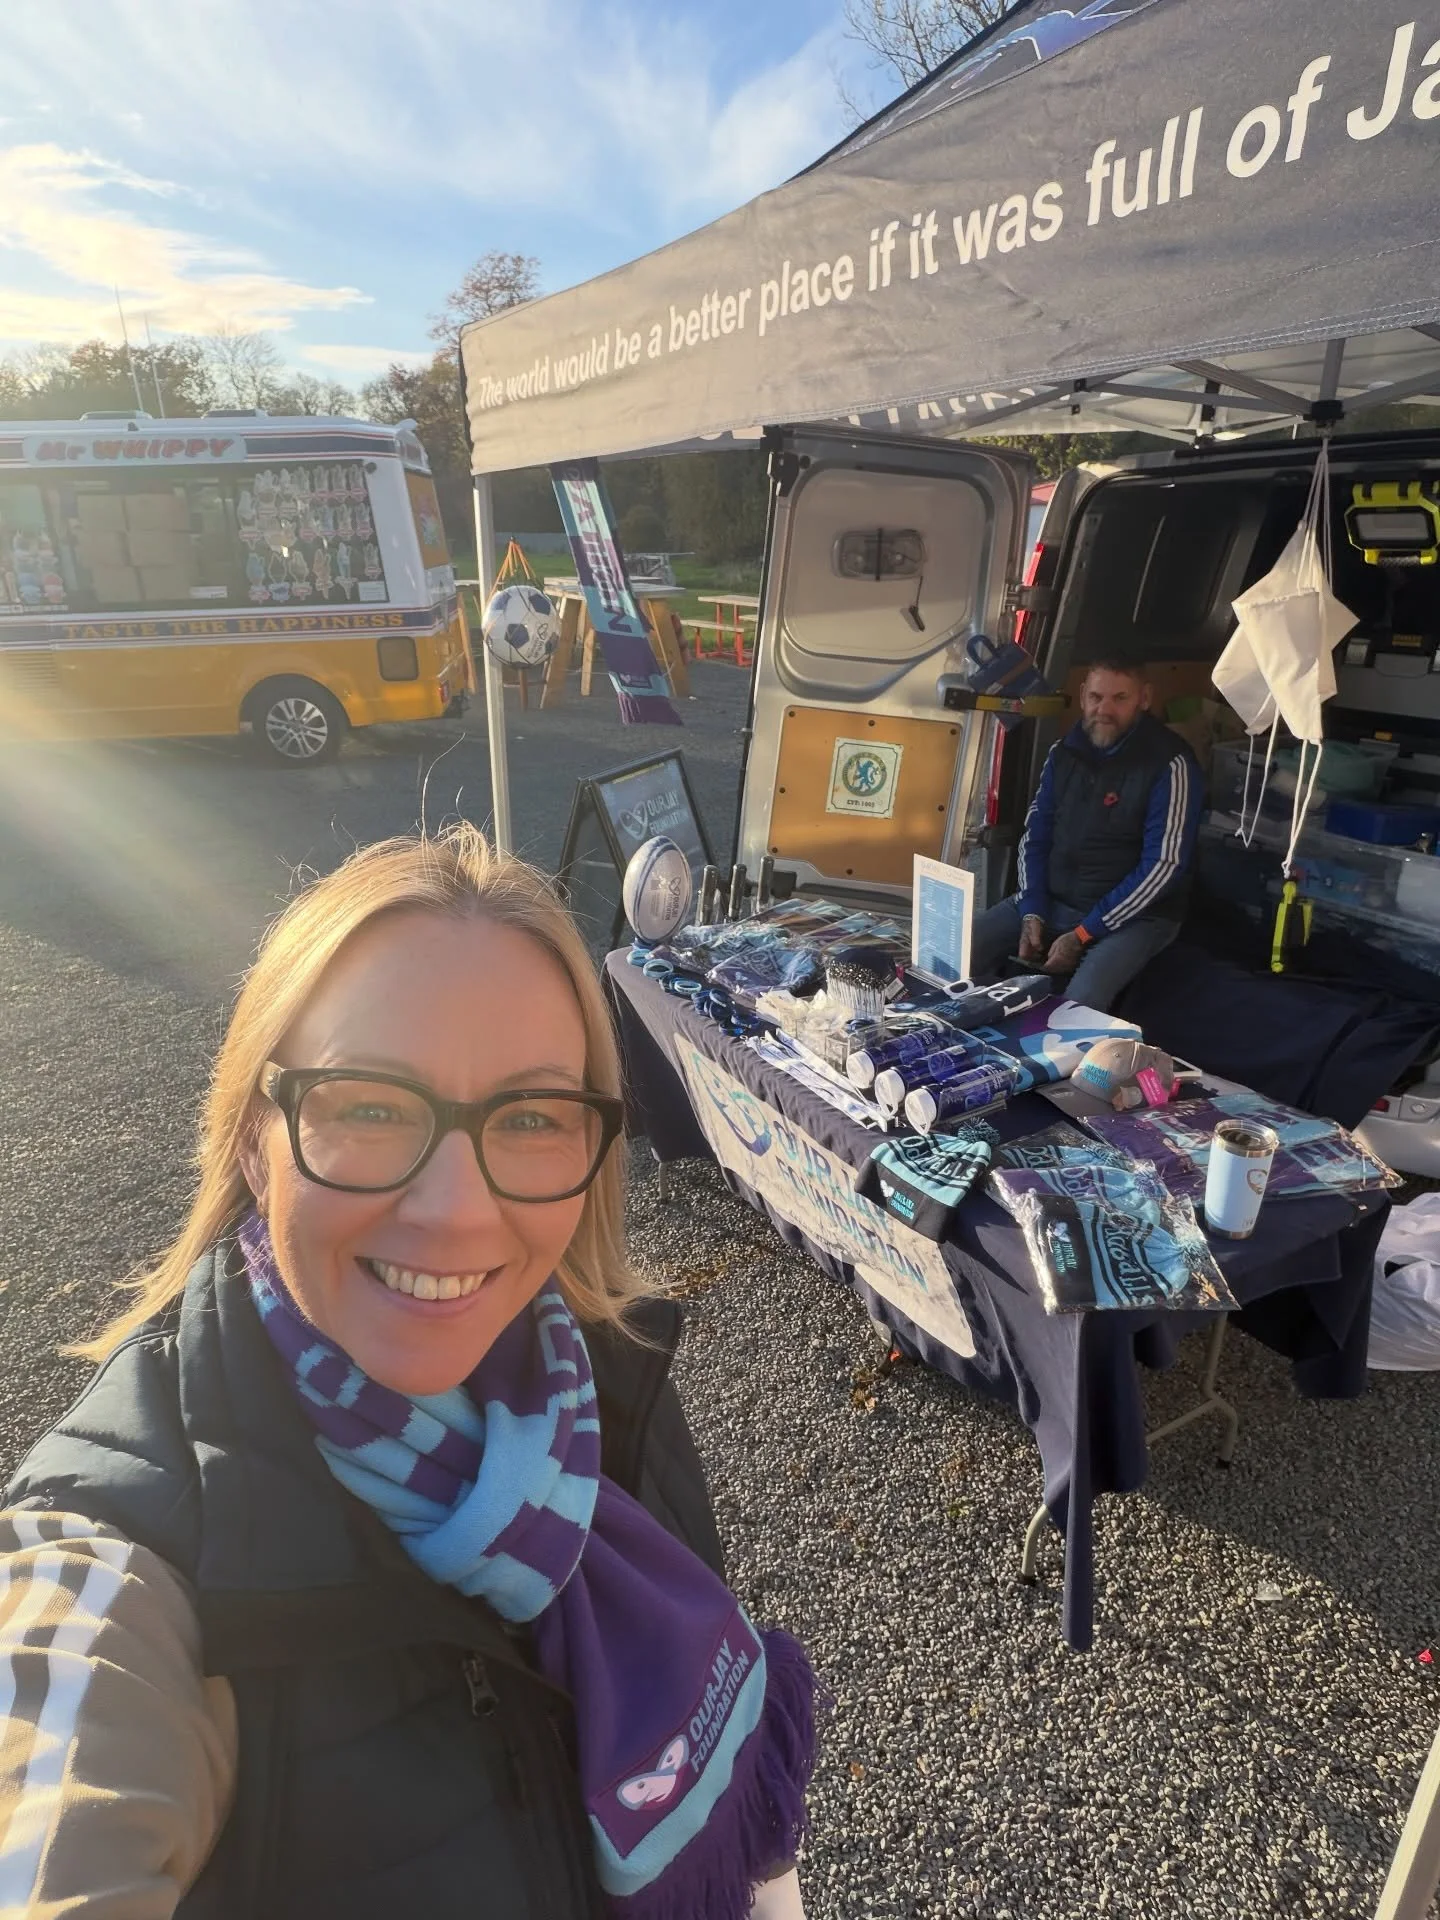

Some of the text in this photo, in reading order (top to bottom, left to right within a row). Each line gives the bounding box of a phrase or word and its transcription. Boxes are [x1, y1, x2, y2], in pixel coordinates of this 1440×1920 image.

[480, 377, 503, 409] The
[506, 356, 549, 402] world
[553, 332, 608, 389] would
[614, 327, 642, 370] be
[647, 323, 663, 359] a
[668, 287, 752, 352] better
[758, 255, 855, 337] place
[868, 220, 900, 291] if
[909, 208, 939, 279] it
[953, 181, 1064, 265] was
[1085, 106, 1204, 226] full
[1226, 55, 1332, 178] of
[35, 438, 235, 460] Mr WHIPPY
[64, 613, 405, 639] TASTE THE HAPPINESS
[690, 1649, 750, 1773] FOUNDATION
